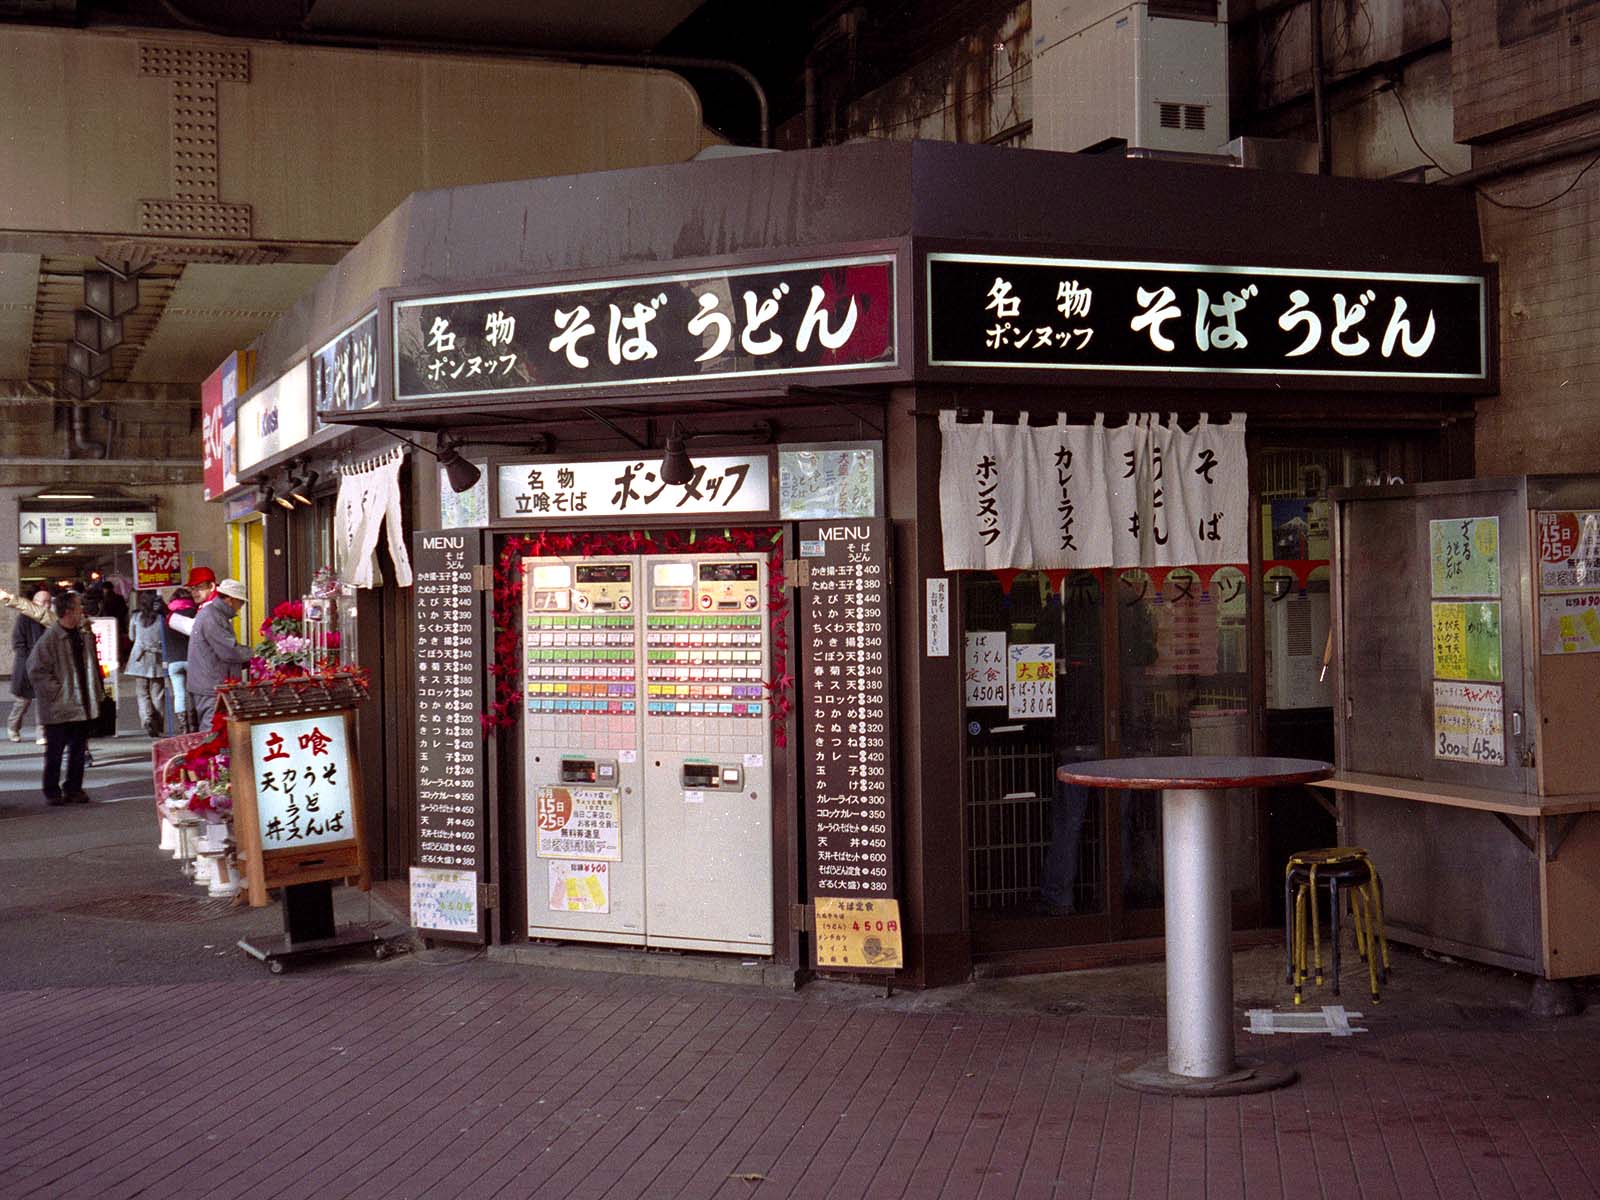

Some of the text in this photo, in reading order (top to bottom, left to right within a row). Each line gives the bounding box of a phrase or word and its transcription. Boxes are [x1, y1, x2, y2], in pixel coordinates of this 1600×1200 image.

[985, 277, 1435, 357] 名物 そば うどん
[428, 281, 858, 369] 名物 そば うどん
[986, 323, 1093, 349] ポンヌッフ
[427, 353, 517, 383] ポンヌッフ
[527, 468, 575, 490] 名物
[975, 455, 1001, 546] ポンヌッフ
[1054, 445, 1078, 551] カレーライス
[1195, 449, 1224, 542] そば
[515, 491, 588, 514] 立喰そば
[819, 527, 869, 542] MENU
[1543, 525, 1571, 542] 15日
[424, 537, 463, 549] MENU
[847, 543, 870, 552] そば
[847, 553, 870, 562] うどん
[1543, 543, 1572, 561] 25日
[864, 565, 880, 573] 400
[864, 580, 880, 588] 380
[813, 594, 854, 604] えび天
[813, 609, 880, 618] いか天 390
[814, 623, 881, 633] ちくわ天 370
[866, 638, 881, 646] 340
[814, 652, 881, 661] ごぼう天 340
[973, 650, 1002, 663] うどん
[1011, 646, 1052, 661] ざる
[966, 667, 1000, 683] 定食
[1018, 663, 1053, 679] 大盛
[815, 681, 882, 689] キス天 380
[815, 695, 882, 704] コロッケ 340
[973, 686, 1004, 702] 450円
[1022, 698, 1053, 713] 380円
[815, 709, 883, 718] わかめ 340
[816, 724, 883, 732] たぬき 320
[262, 727, 332, 762] 立喰
[816, 738, 857, 746] きつね
[816, 752, 884, 761] カレー 420
[867, 767, 884, 775] 300
[304, 766, 323, 836] うどん
[323, 763, 344, 832] そば
[817, 795, 885, 804] カレーライス 300
[282, 769, 303, 841] カレーライス
[539, 798, 564, 813] 15日
[817, 809, 859, 818] コロッケカレー
[539, 813, 565, 828] 25日
[868, 825, 885, 833] 450
[869, 839, 886, 847] 450
[870, 868, 886, 876] 450
[819, 880, 886, 890] ざる(大盛) 380
[852, 920, 898, 932] 450円
